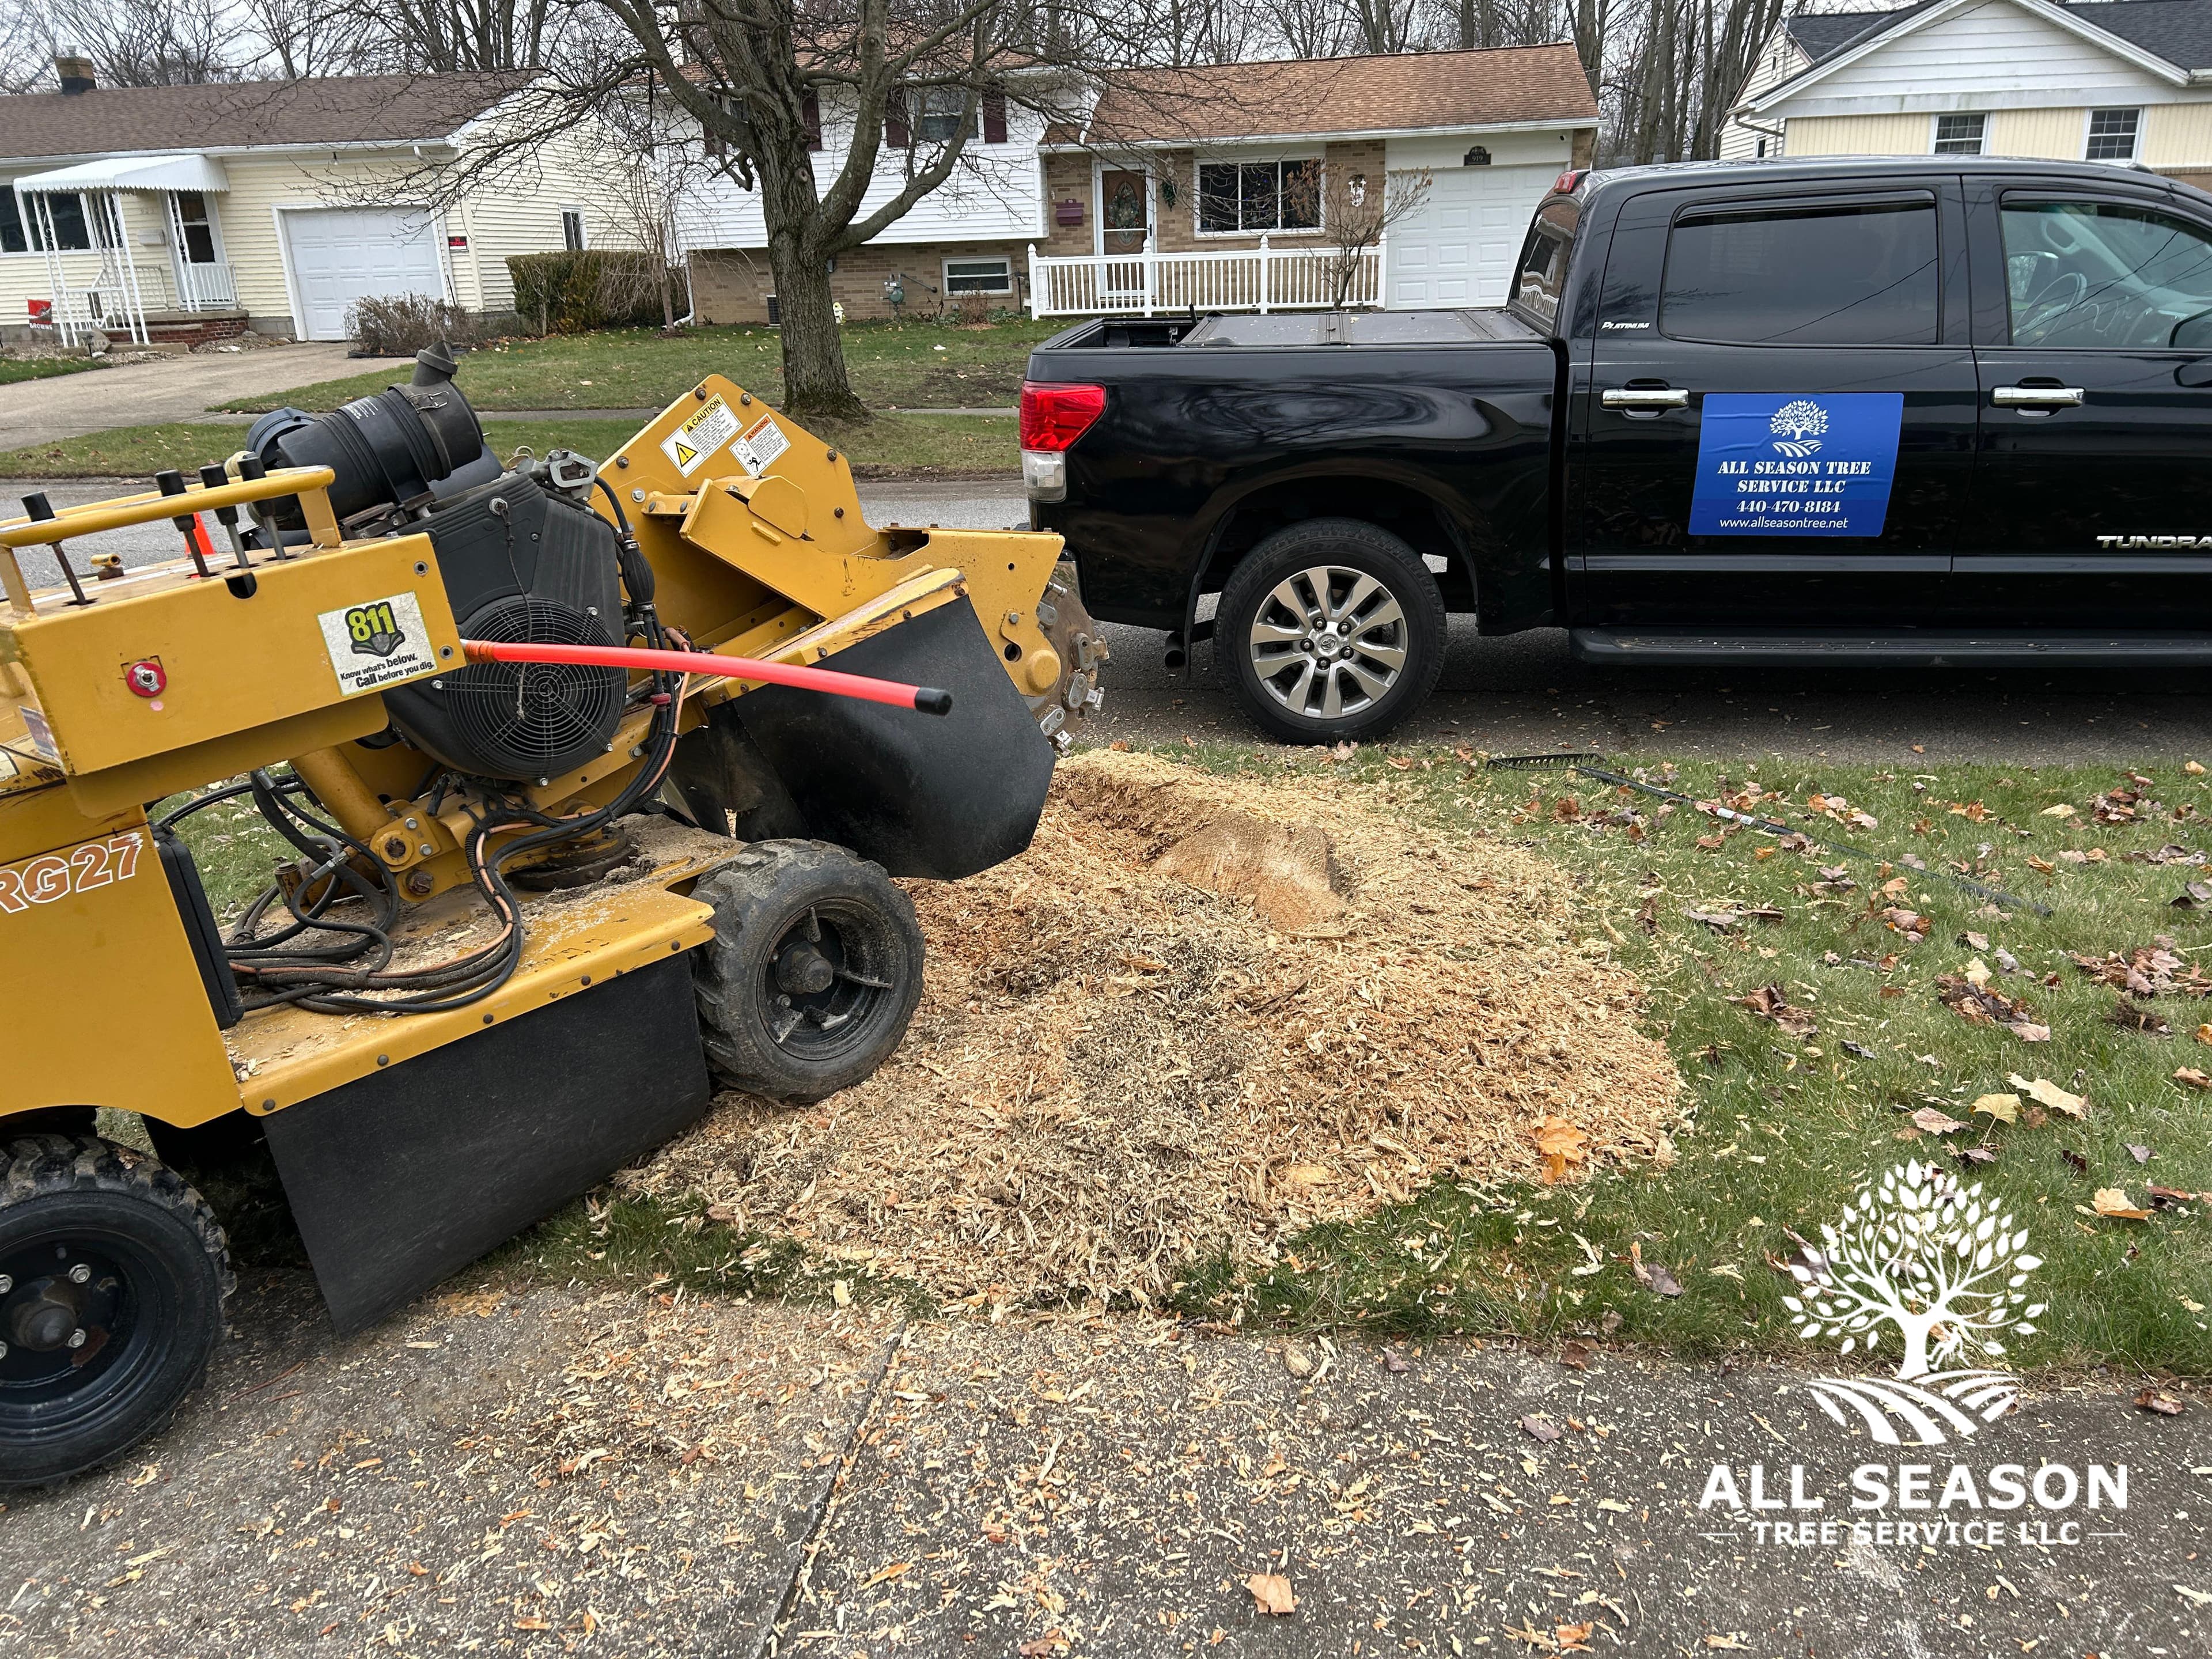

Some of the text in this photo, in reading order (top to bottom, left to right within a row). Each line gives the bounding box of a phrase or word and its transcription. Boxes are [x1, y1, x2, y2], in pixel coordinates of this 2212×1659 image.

[692, 398, 721, 426] CAUTION
[1717, 461, 1872, 475] ALL SEASON TREE
[1737, 480, 1846, 494] SERVICE LLC
[1736, 500, 1841, 513] 440-470-8184
[1719, 516, 1849, 529] www.allseasontree.net
[2096, 535, 2212, 548] TUNDRA
[348, 604, 395, 642] 811
[340, 653, 418, 680] Know what's below.
[355, 661, 435, 688] Call before you dig.
[0, 832, 143, 914] RG27
